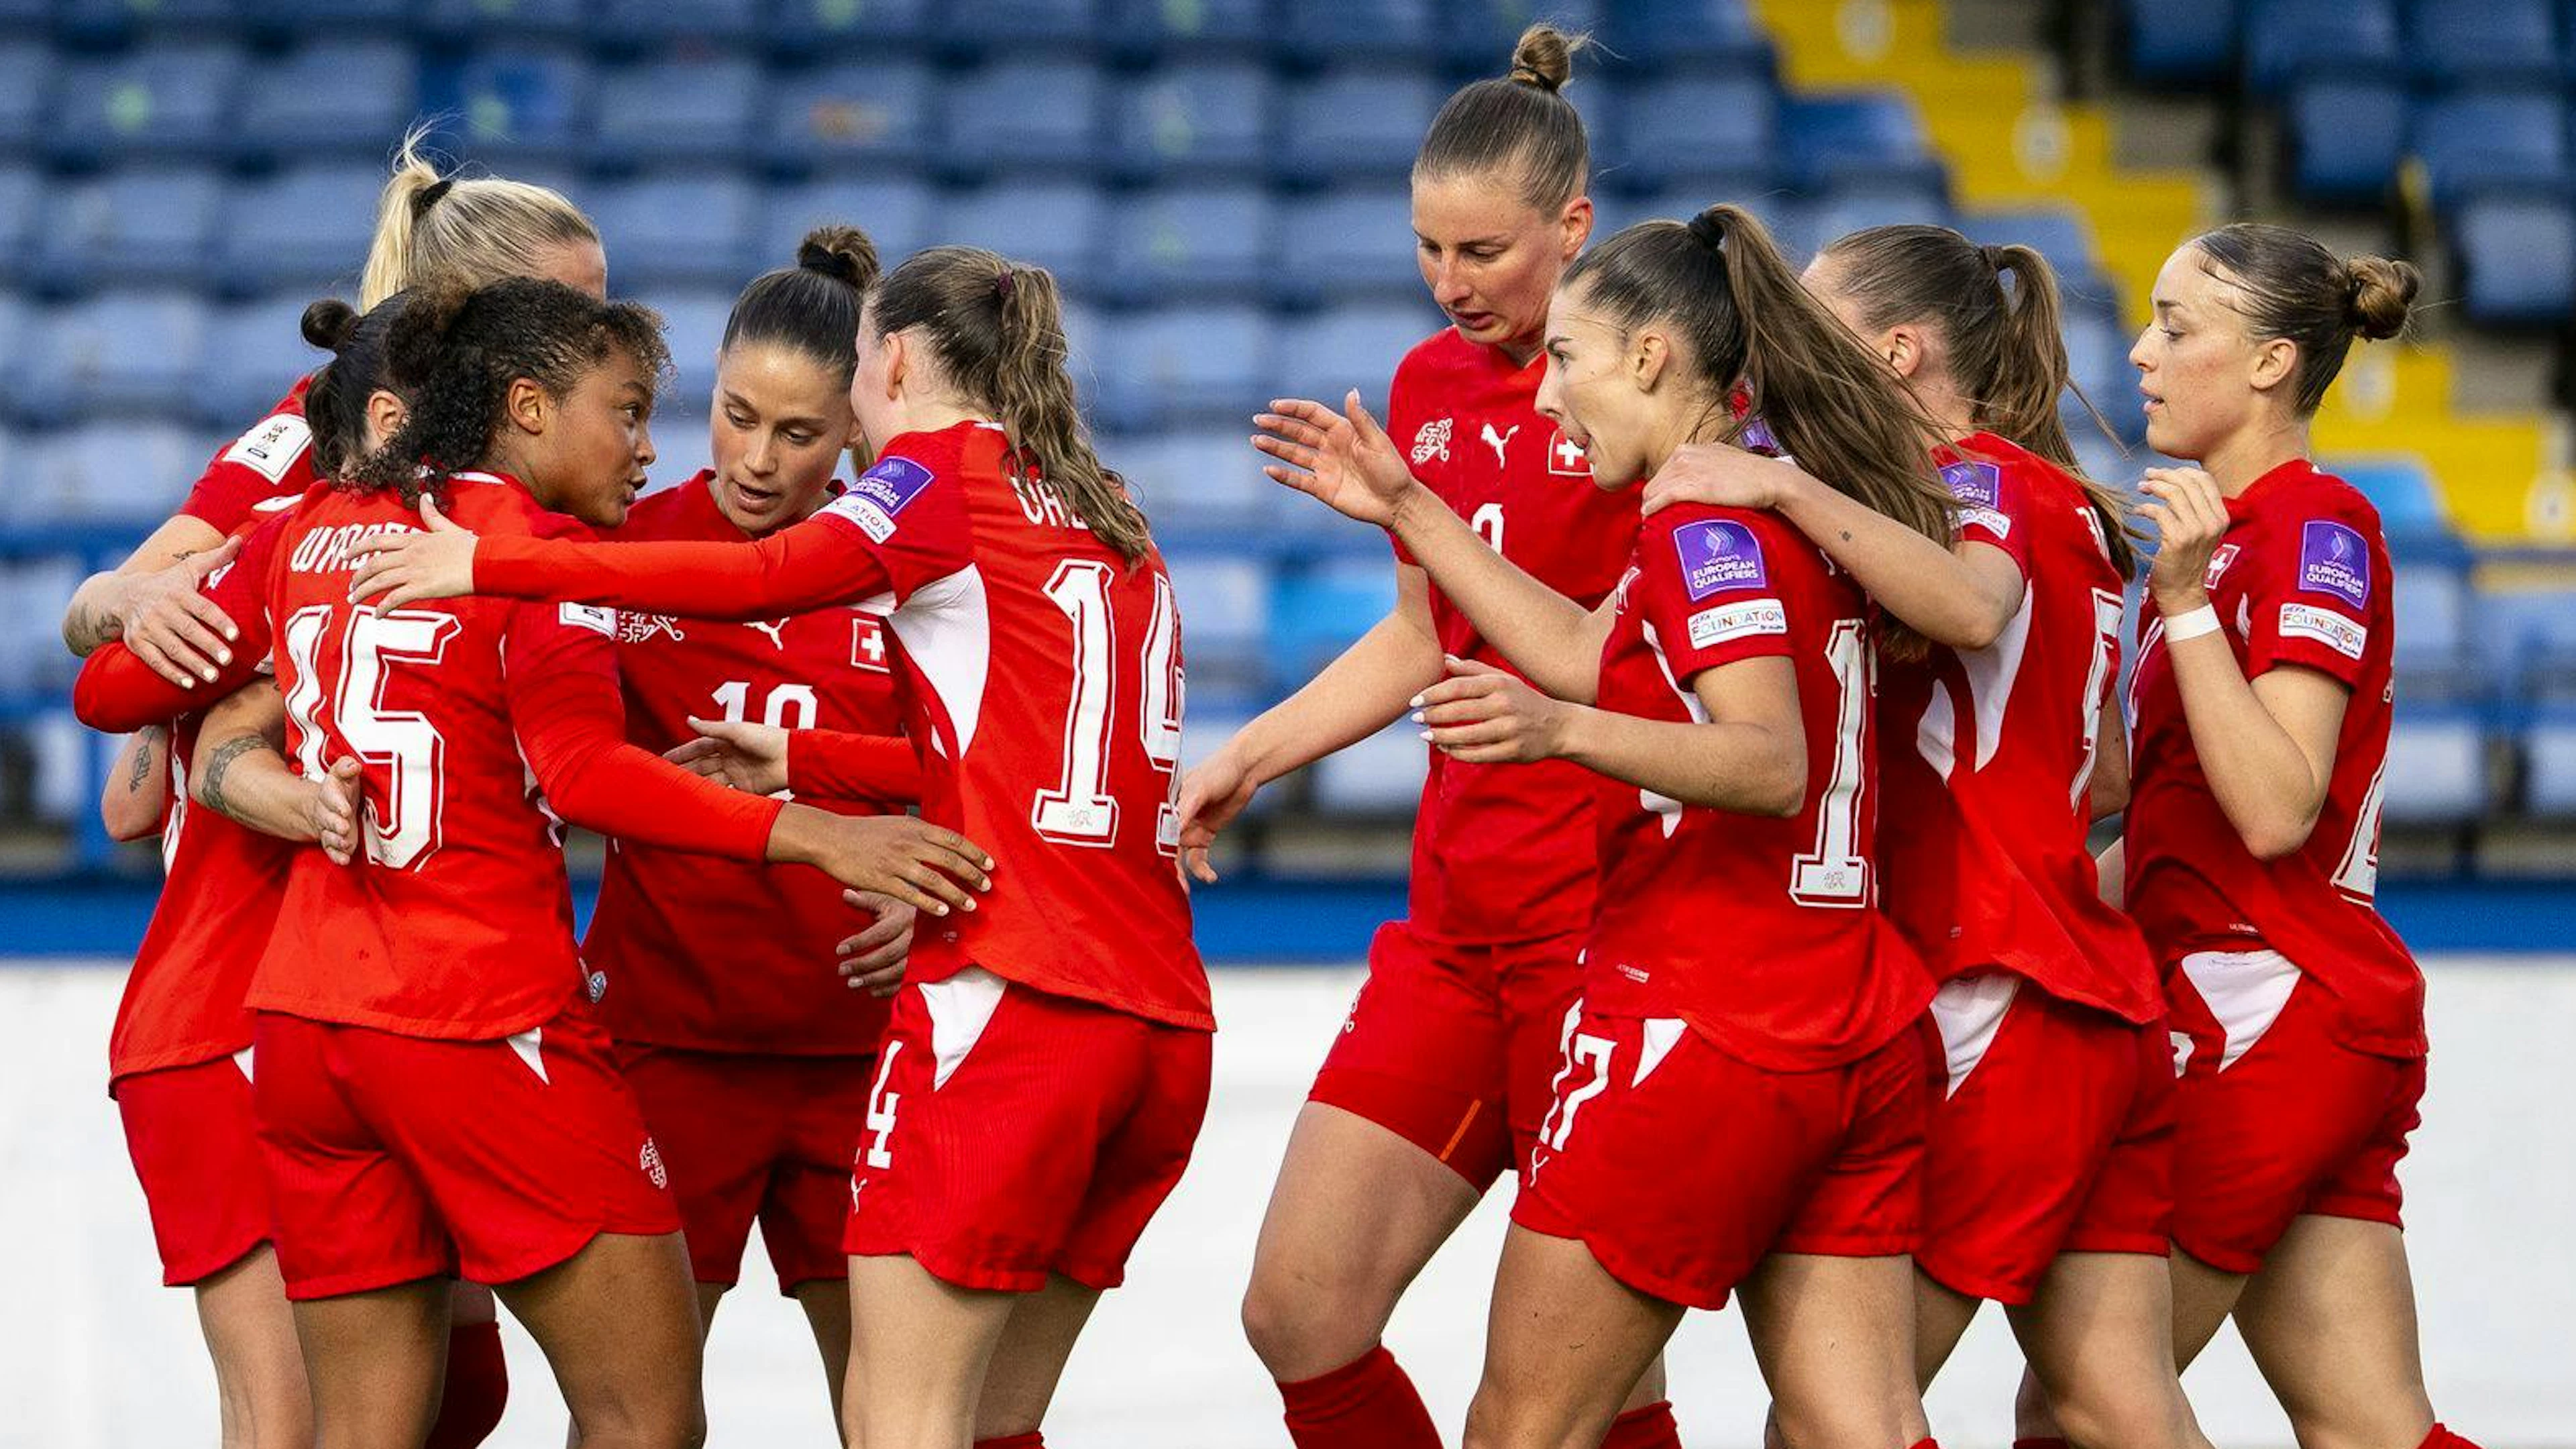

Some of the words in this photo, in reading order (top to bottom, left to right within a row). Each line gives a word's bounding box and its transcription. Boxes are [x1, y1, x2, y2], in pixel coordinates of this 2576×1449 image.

[1693, 561, 1756, 579] EUROPEAN
[1694, 569, 1759, 589] QUALIFIERS
[2309, 564, 2364, 589] EUROPEAN
[2306, 573, 2363, 598] QUALIFIERS
[2284, 613, 2361, 647] FOUNDATION
[285, 604, 462, 873] 15
